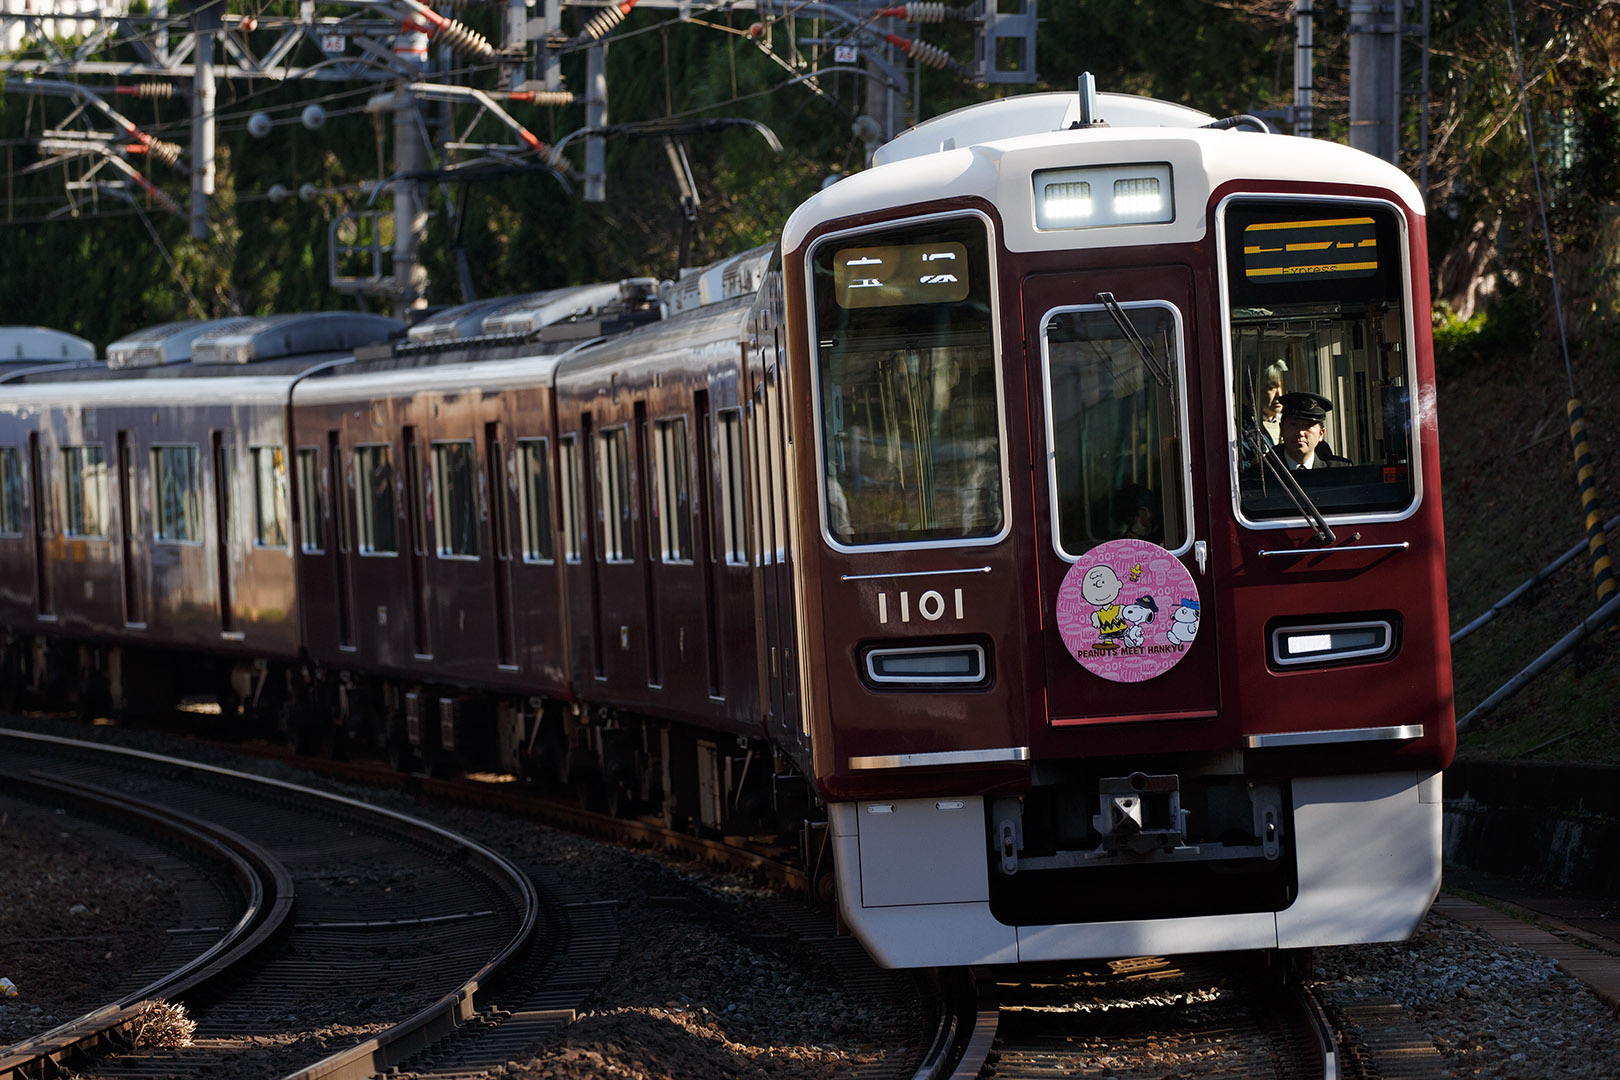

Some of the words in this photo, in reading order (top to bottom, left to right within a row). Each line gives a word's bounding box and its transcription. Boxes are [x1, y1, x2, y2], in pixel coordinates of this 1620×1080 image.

[878, 588, 964, 624] 1101
[1077, 648, 1118, 658] PEANUTS
[1120, 646, 1145, 656] MEET
[1147, 643, 1185, 654] HANKYU
